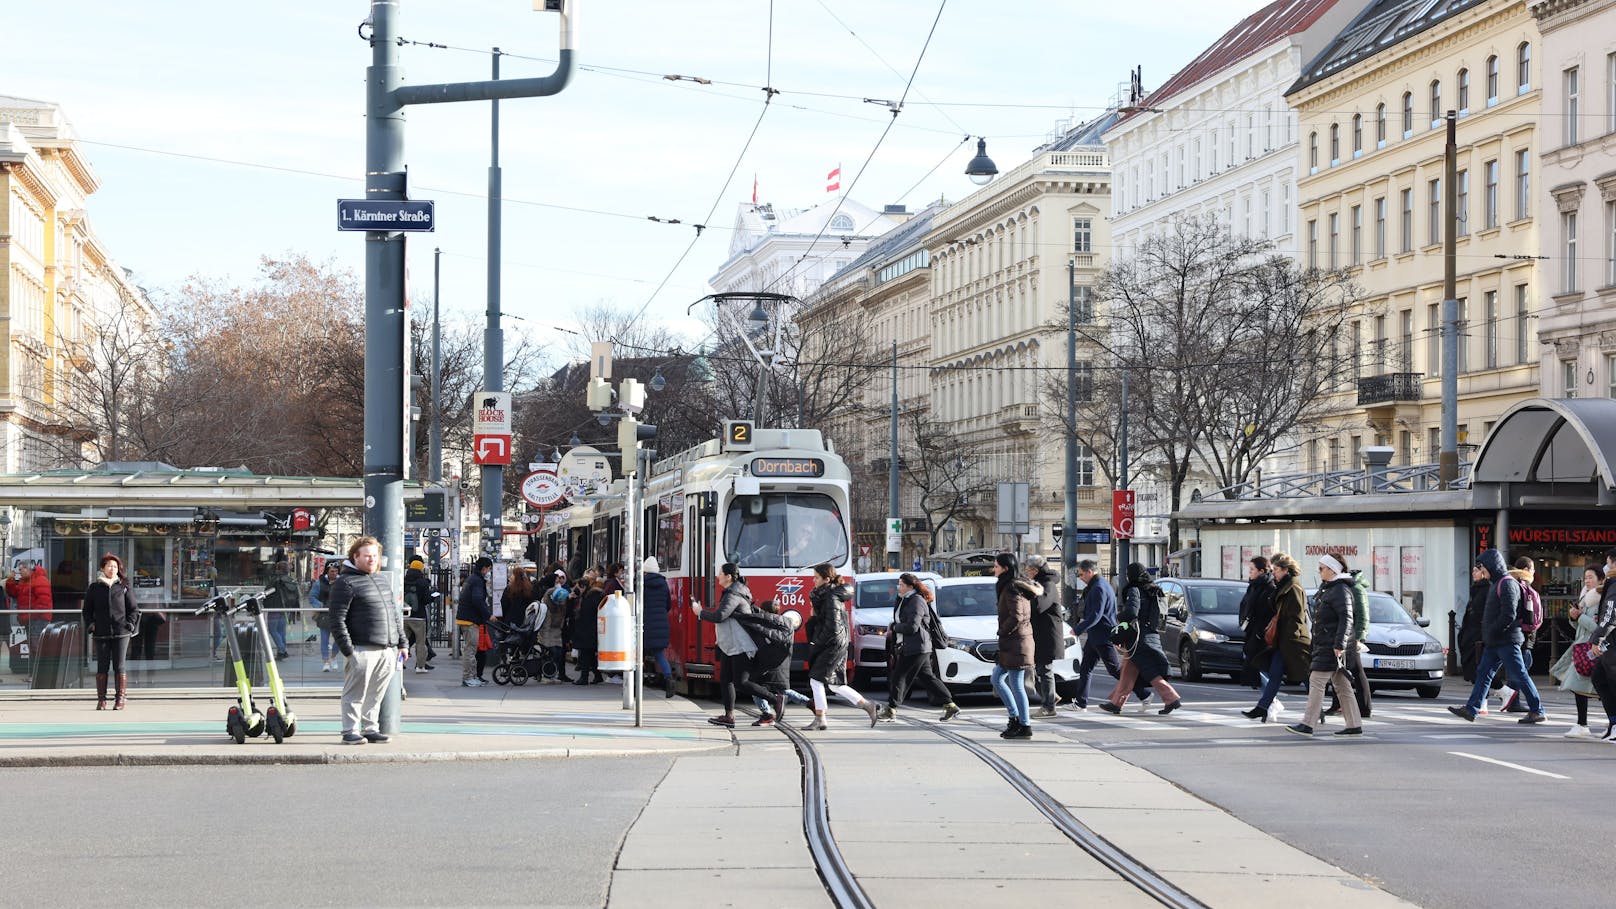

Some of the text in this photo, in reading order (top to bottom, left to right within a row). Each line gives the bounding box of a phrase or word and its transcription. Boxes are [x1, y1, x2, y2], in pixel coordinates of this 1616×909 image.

[341, 209, 431, 222] 1., Kärntner Straße
[734, 426, 747, 441] 2
[758, 459, 818, 473] Dornbach
[1510, 528, 1616, 543] WÜRSTELSTAND
[773, 594, 805, 606] 4084
